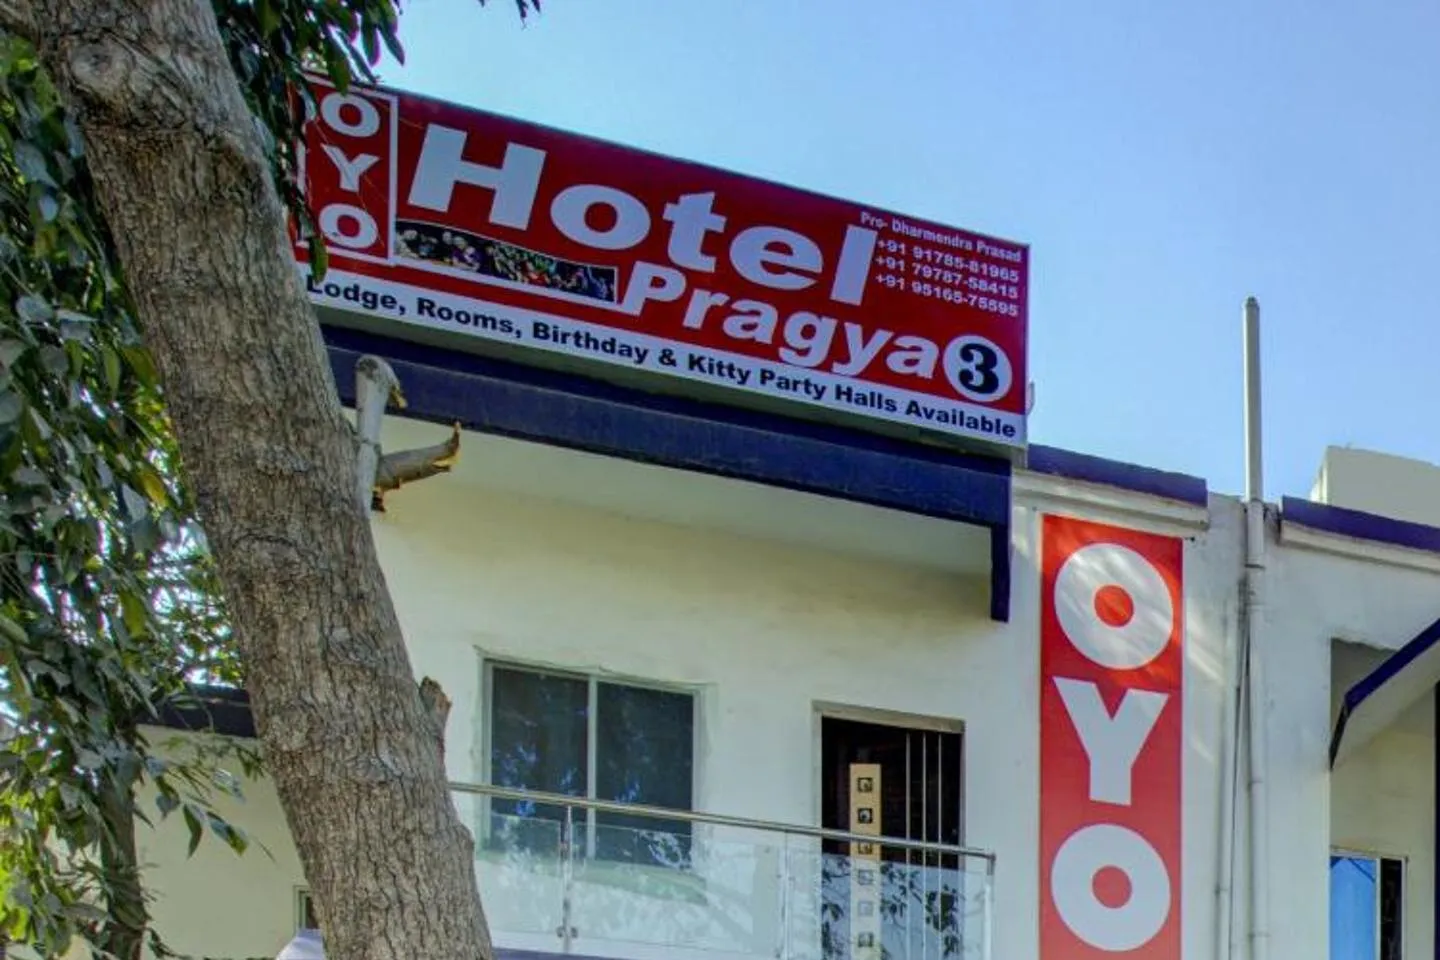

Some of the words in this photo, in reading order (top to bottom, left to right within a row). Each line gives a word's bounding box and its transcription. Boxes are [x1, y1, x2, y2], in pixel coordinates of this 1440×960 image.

[319, 92, 381, 250] OYO
[408, 124, 878, 306] Hotel
[875, 273, 905, 290] +91
[876, 255, 905, 271] +91
[912, 262, 1018, 299] 79787-58415
[877, 239, 906, 255] +91
[892, 218, 973, 251] Dharmendra
[976, 239, 1022, 262] Prasad
[306, 274, 406, 315] Lodge,
[417, 296, 522, 338] Rooms,
[532, 322, 650, 366] Birthday
[658, 348, 677, 367] &
[688, 353, 751, 385] Kitty
[759, 367, 827, 401] Party
[835, 384, 898, 413] Halls
[905, 401, 1017, 438] Available
[619, 261, 940, 379] Pragya
[956, 342, 1000, 395] 3
[1050, 543, 1174, 952] OYO
